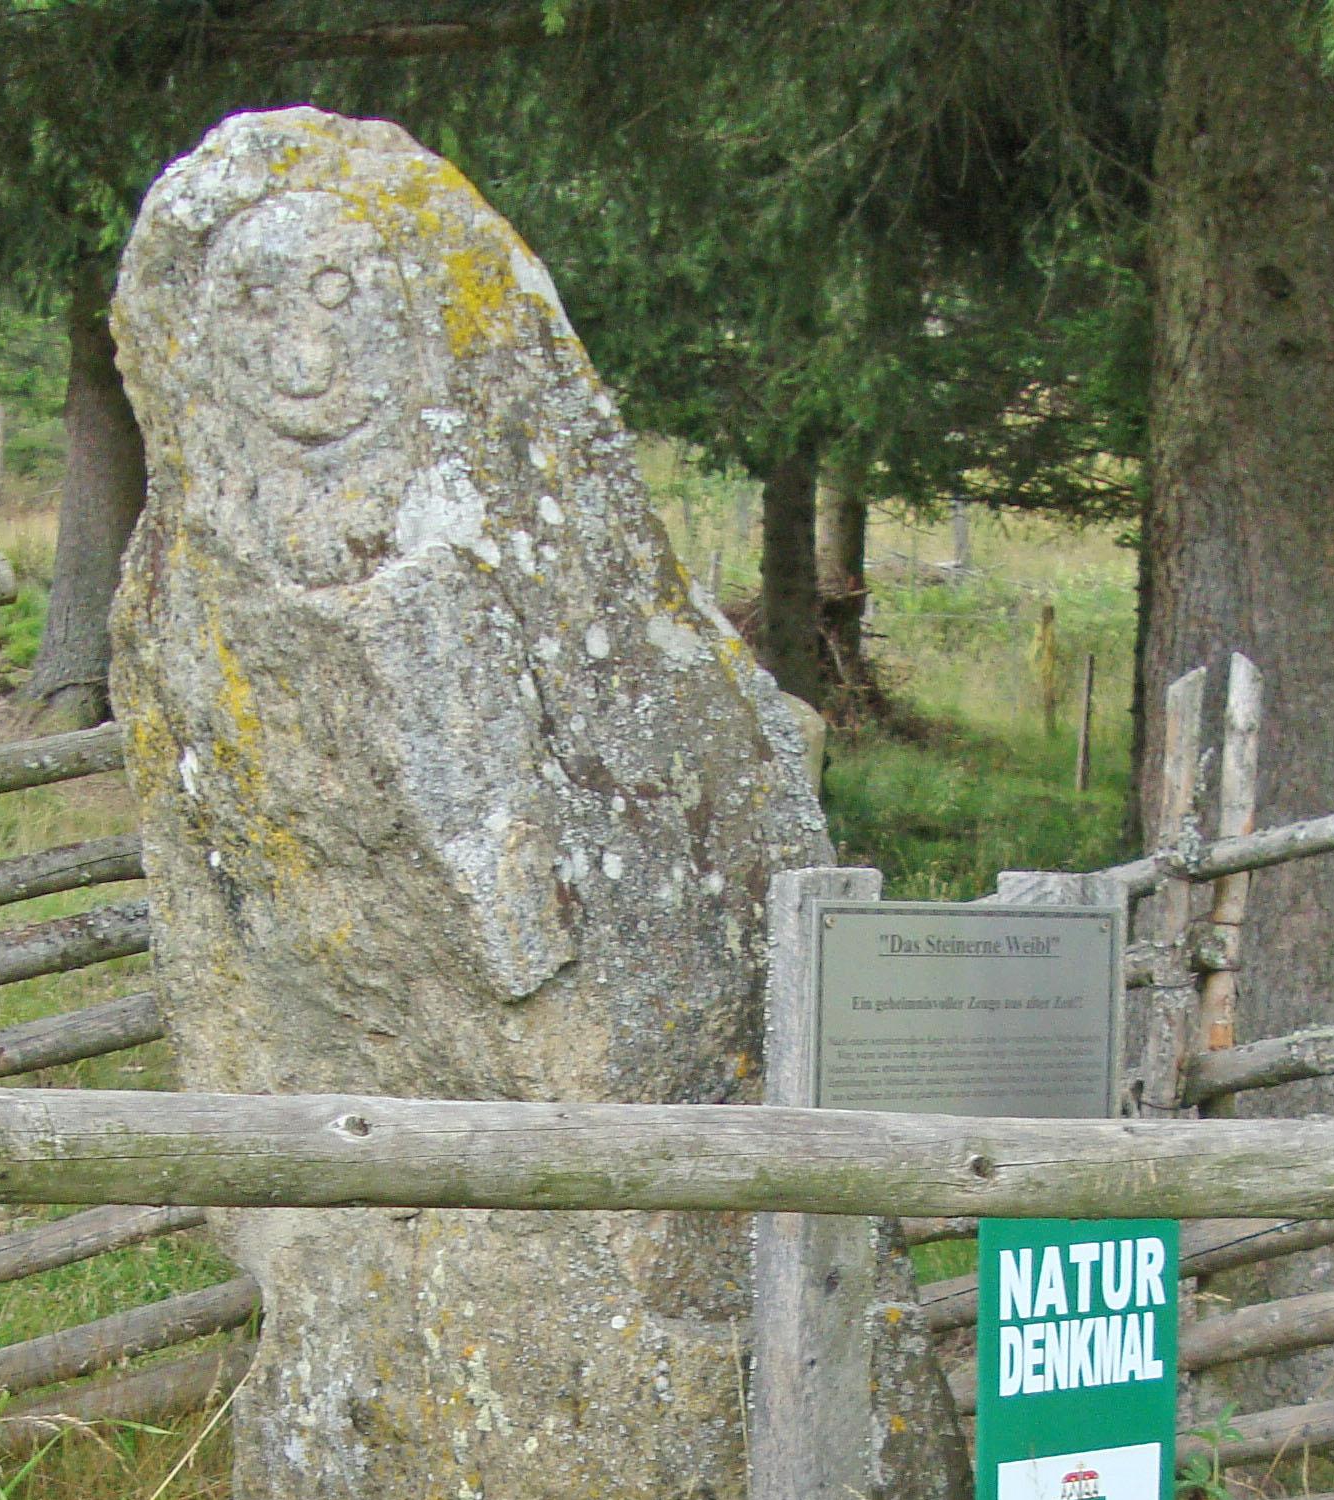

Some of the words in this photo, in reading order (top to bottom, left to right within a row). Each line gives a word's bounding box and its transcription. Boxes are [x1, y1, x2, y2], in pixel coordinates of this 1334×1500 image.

[925, 933, 1002, 954] Steinerne
[999, 1237, 1166, 1321] NATUR
[999, 1311, 1163, 1397] DENKMAL
